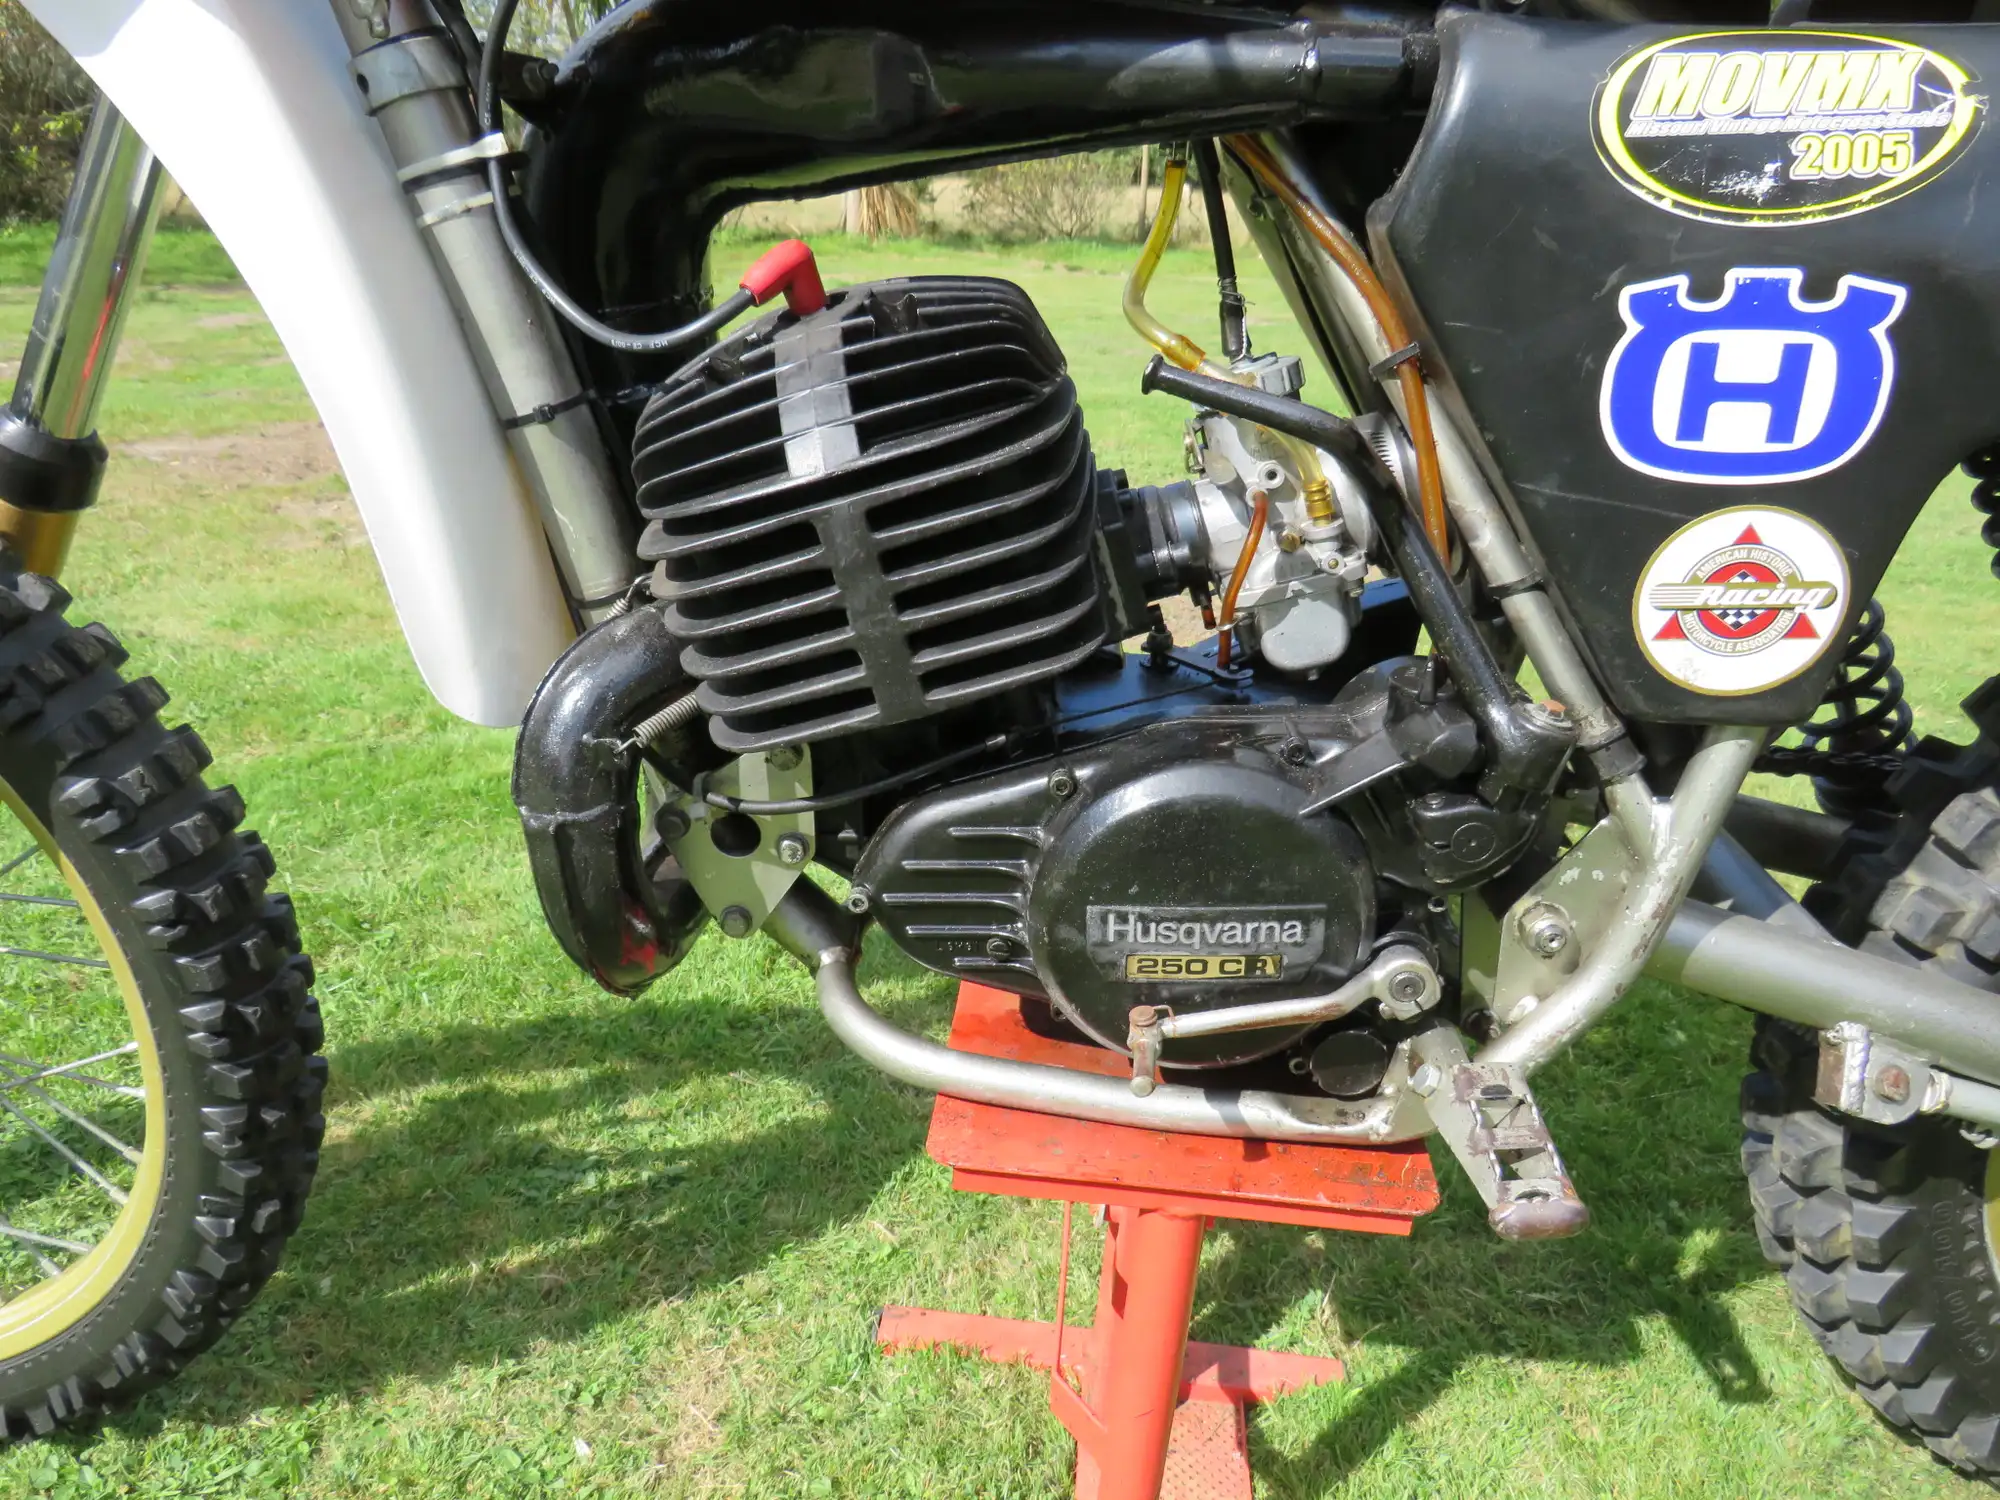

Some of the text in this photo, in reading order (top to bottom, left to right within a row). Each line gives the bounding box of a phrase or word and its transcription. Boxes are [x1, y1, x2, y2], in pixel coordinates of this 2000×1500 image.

[1630, 51, 1924, 119] MOVMX
[1790, 131, 1914, 180] 2005
[1697, 547, 1793, 579] AMERICAN HISTORIC
[1694, 583, 1833, 614] Racing
[1682, 610, 1796, 652] MOTORCYCLE ASSOCIATION
[1107, 913, 1304, 949] Husqvarna
[1136, 958, 1208, 975] 250
